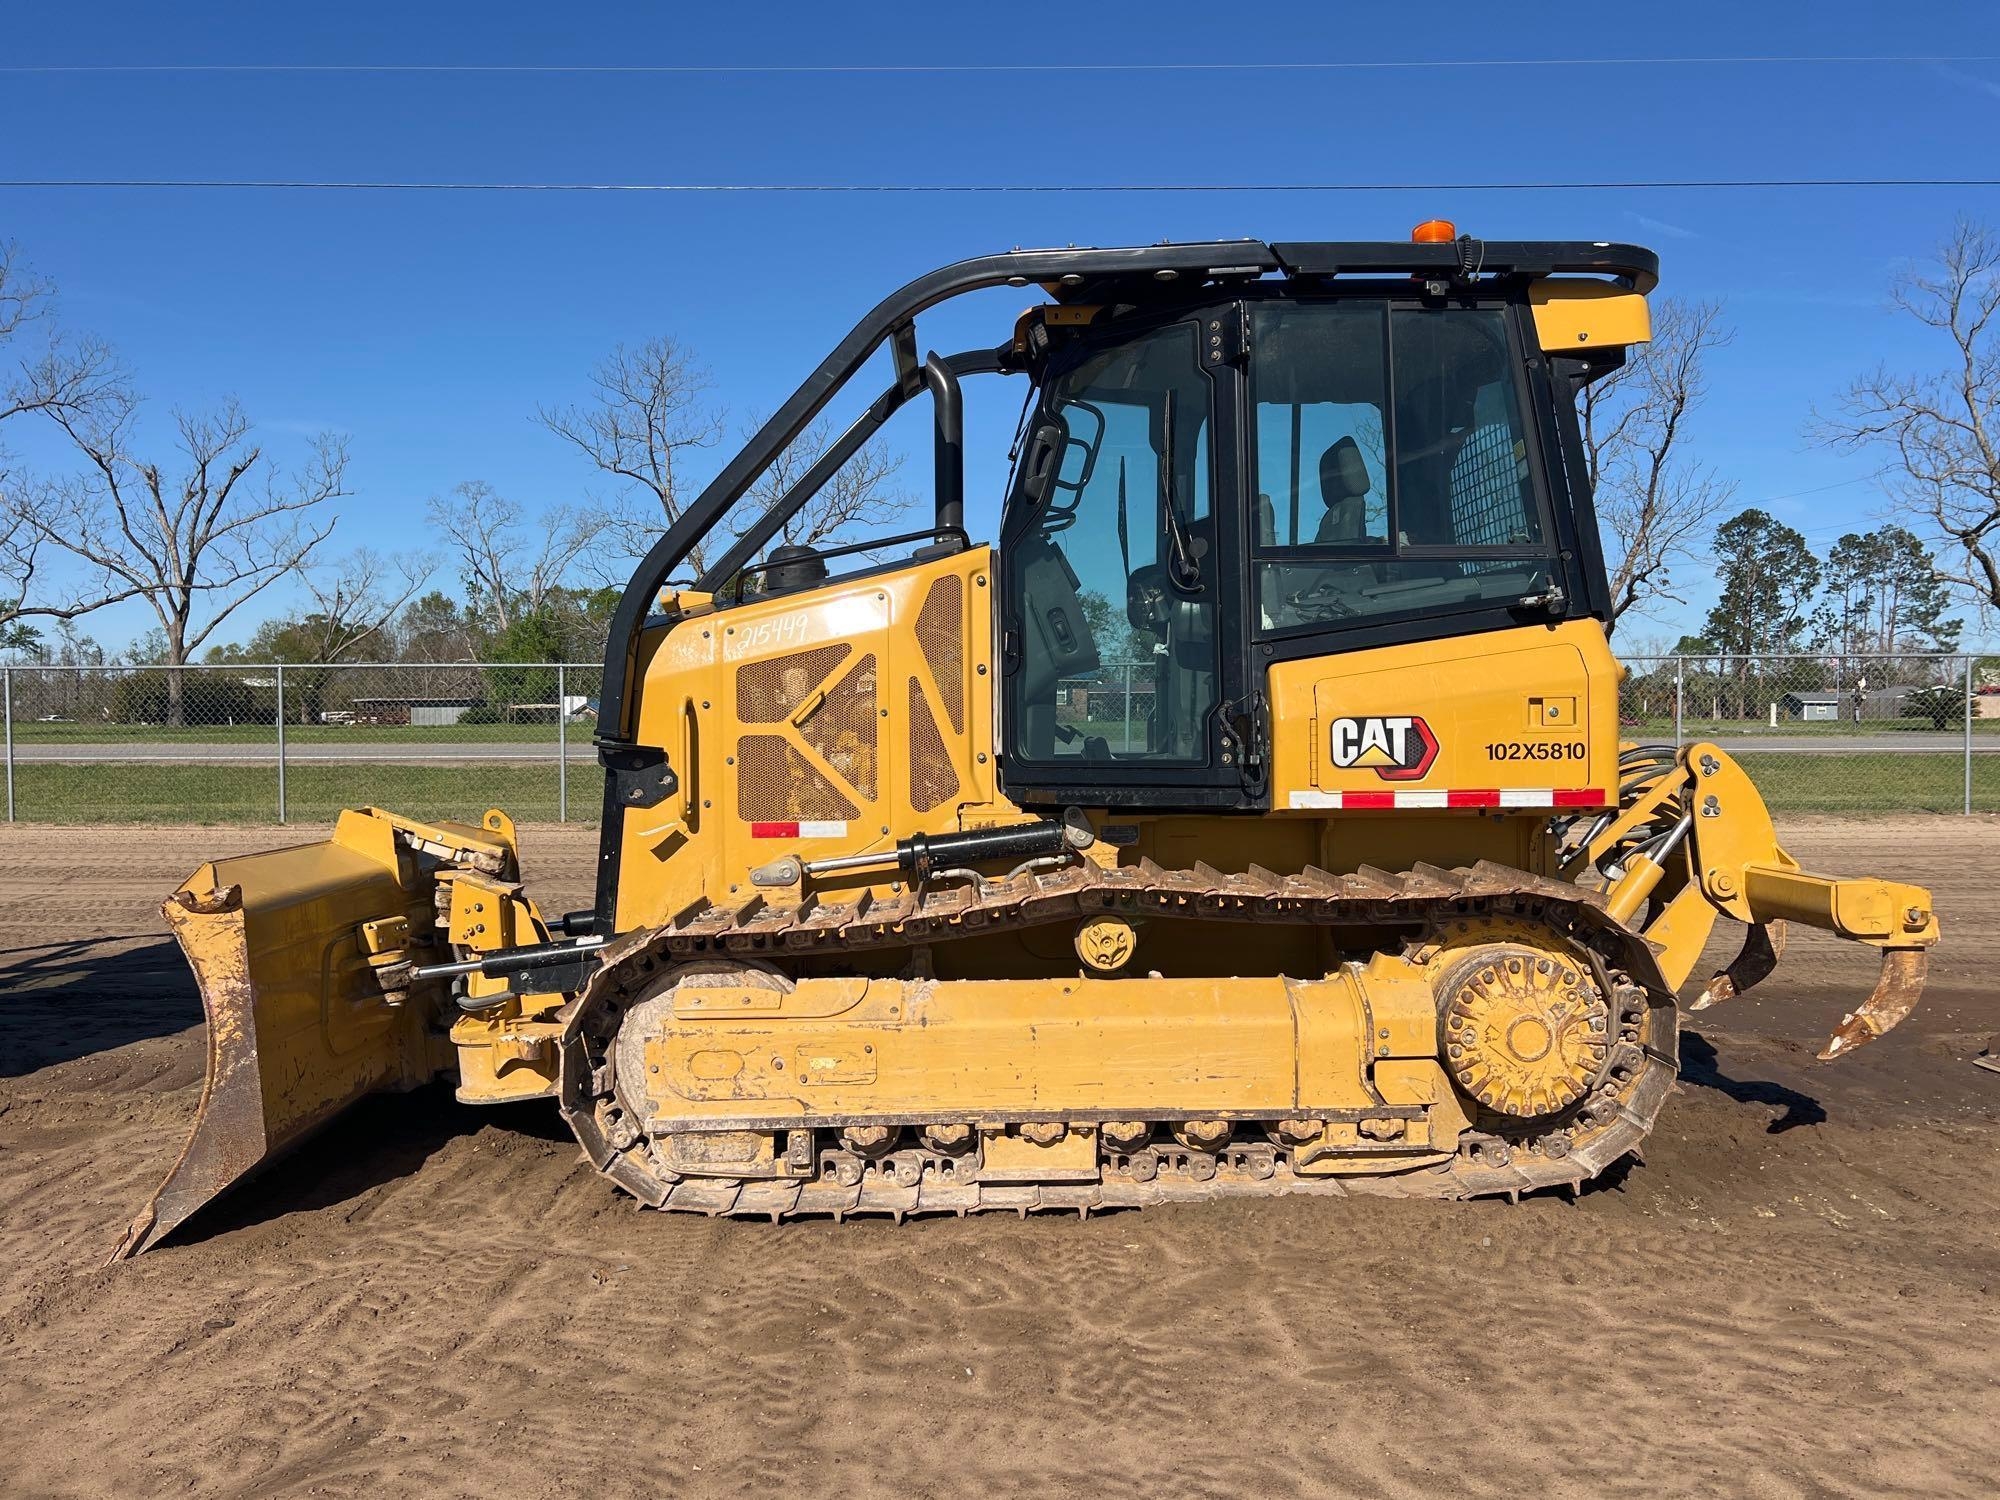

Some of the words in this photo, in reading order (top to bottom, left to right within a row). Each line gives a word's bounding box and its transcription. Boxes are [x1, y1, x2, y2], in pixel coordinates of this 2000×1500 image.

[736, 614, 808, 651] 215449
[1332, 718, 1412, 767] CAT
[1485, 742, 1586, 761] 102X5810
